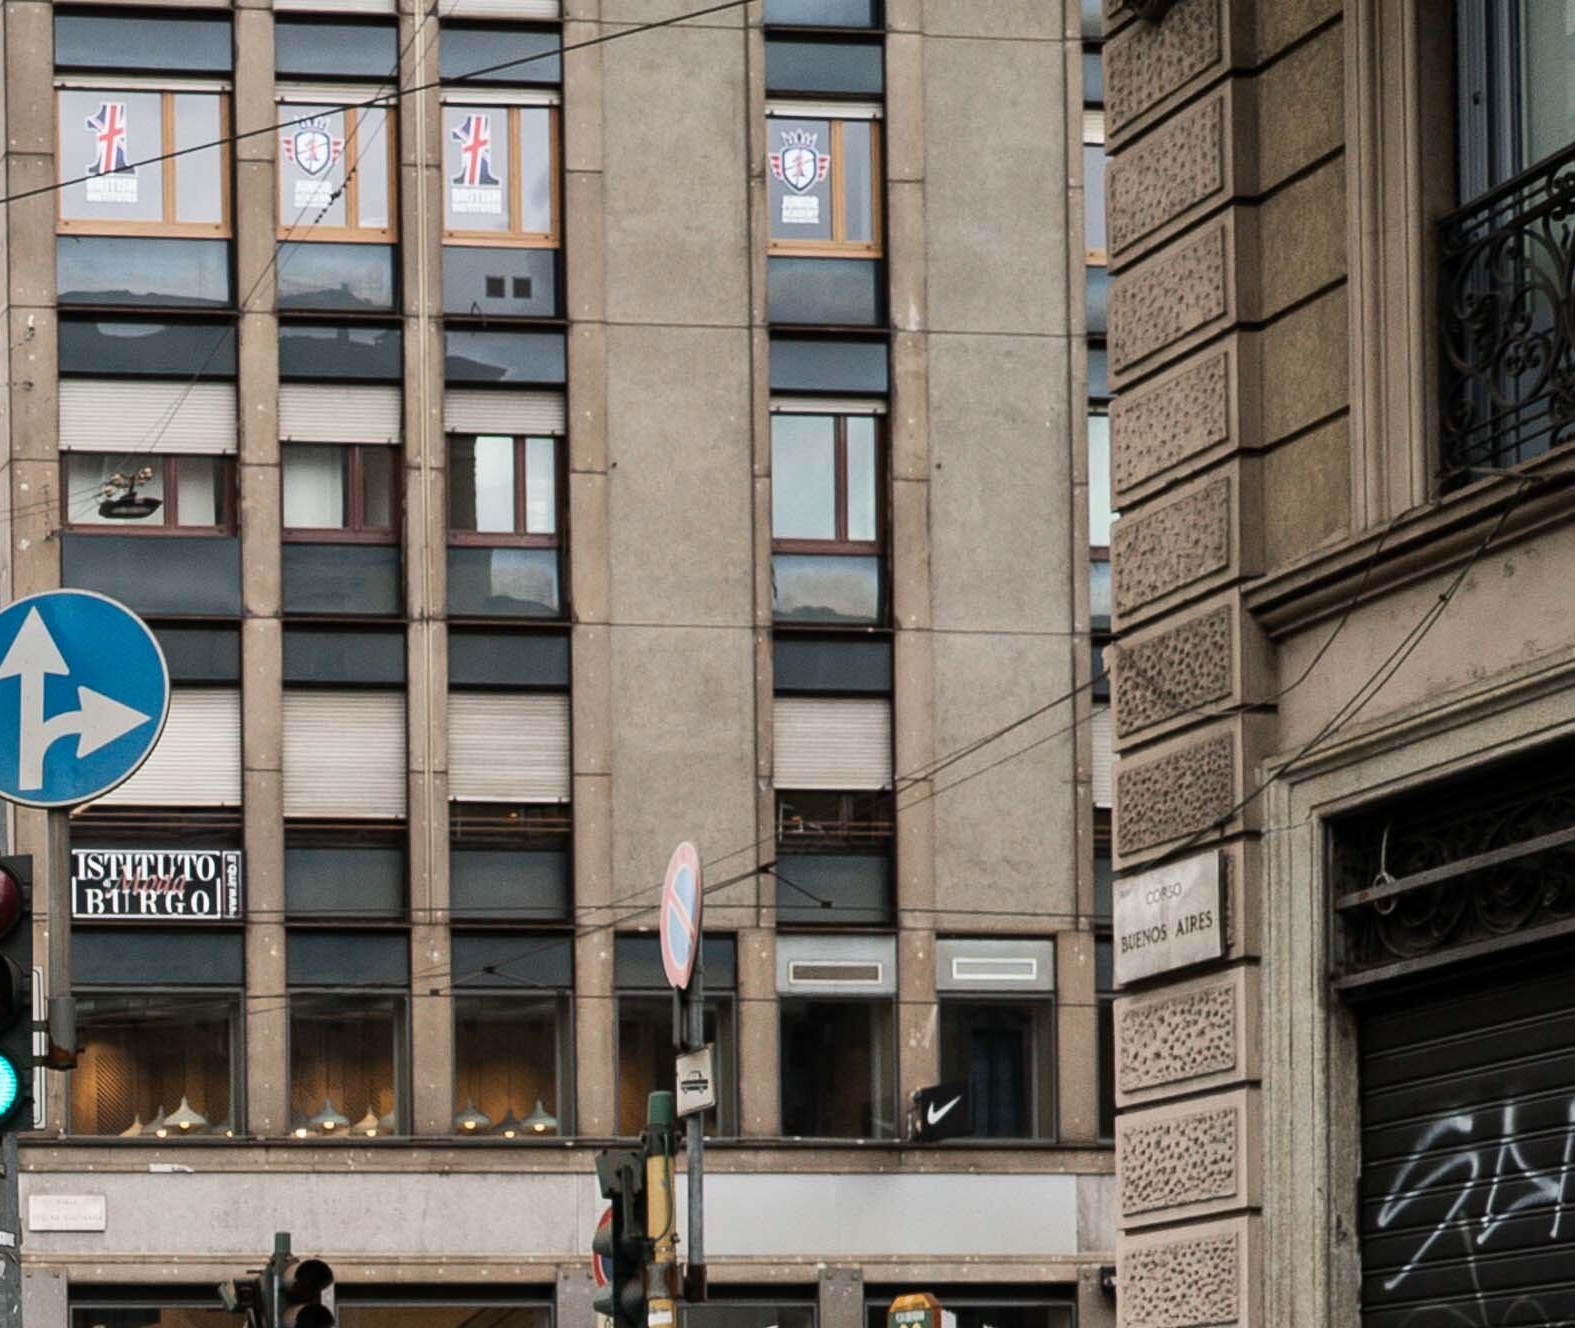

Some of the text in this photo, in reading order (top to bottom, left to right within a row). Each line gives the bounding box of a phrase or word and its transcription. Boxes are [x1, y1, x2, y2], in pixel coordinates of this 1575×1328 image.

[77, 853, 216, 881] ISTITUTO
[85, 889, 210, 914] BURGO
[1146, 881, 1182, 905] CORSO
[1121, 910, 1213, 954] BUENOS AIRES
